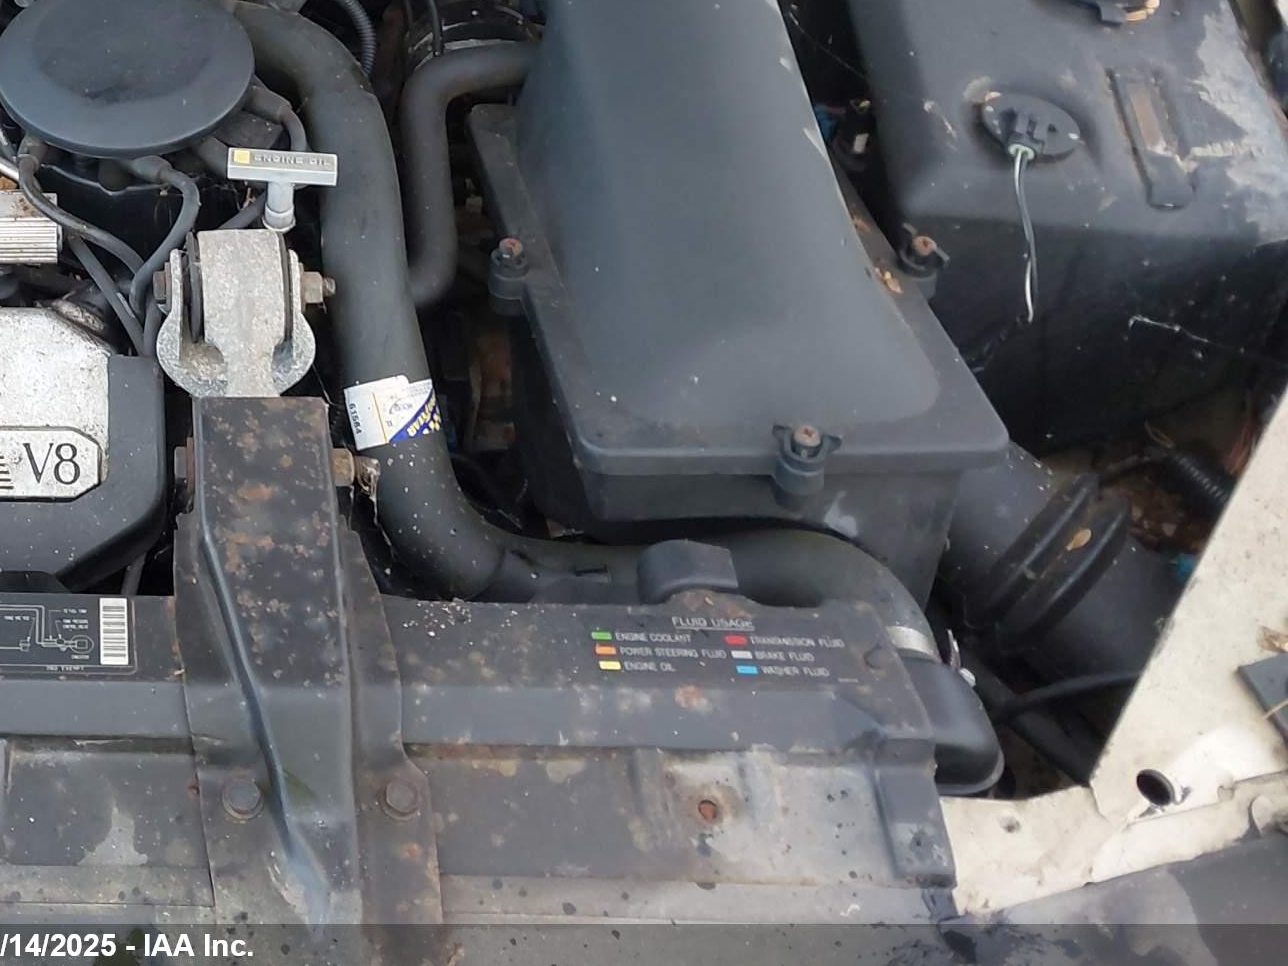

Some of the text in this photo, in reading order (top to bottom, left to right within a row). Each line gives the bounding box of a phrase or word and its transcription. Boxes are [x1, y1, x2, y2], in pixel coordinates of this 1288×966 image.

[254, 154, 332, 167] ENGINE OIL
[22, 442, 81, 485] V8
[672, 616, 753, 628] FLUID USAGE
[615, 632, 692, 643] ENGINE COOLANT
[750, 635, 845, 648] TRANSMISSION FLUID
[620, 646, 727, 659] POWER STEERING FLUID
[754, 650, 816, 662] BRAKE FLUID
[623, 661, 677, 672] ENGINE OIL
[760, 665, 831, 677] WASHER FLUID
